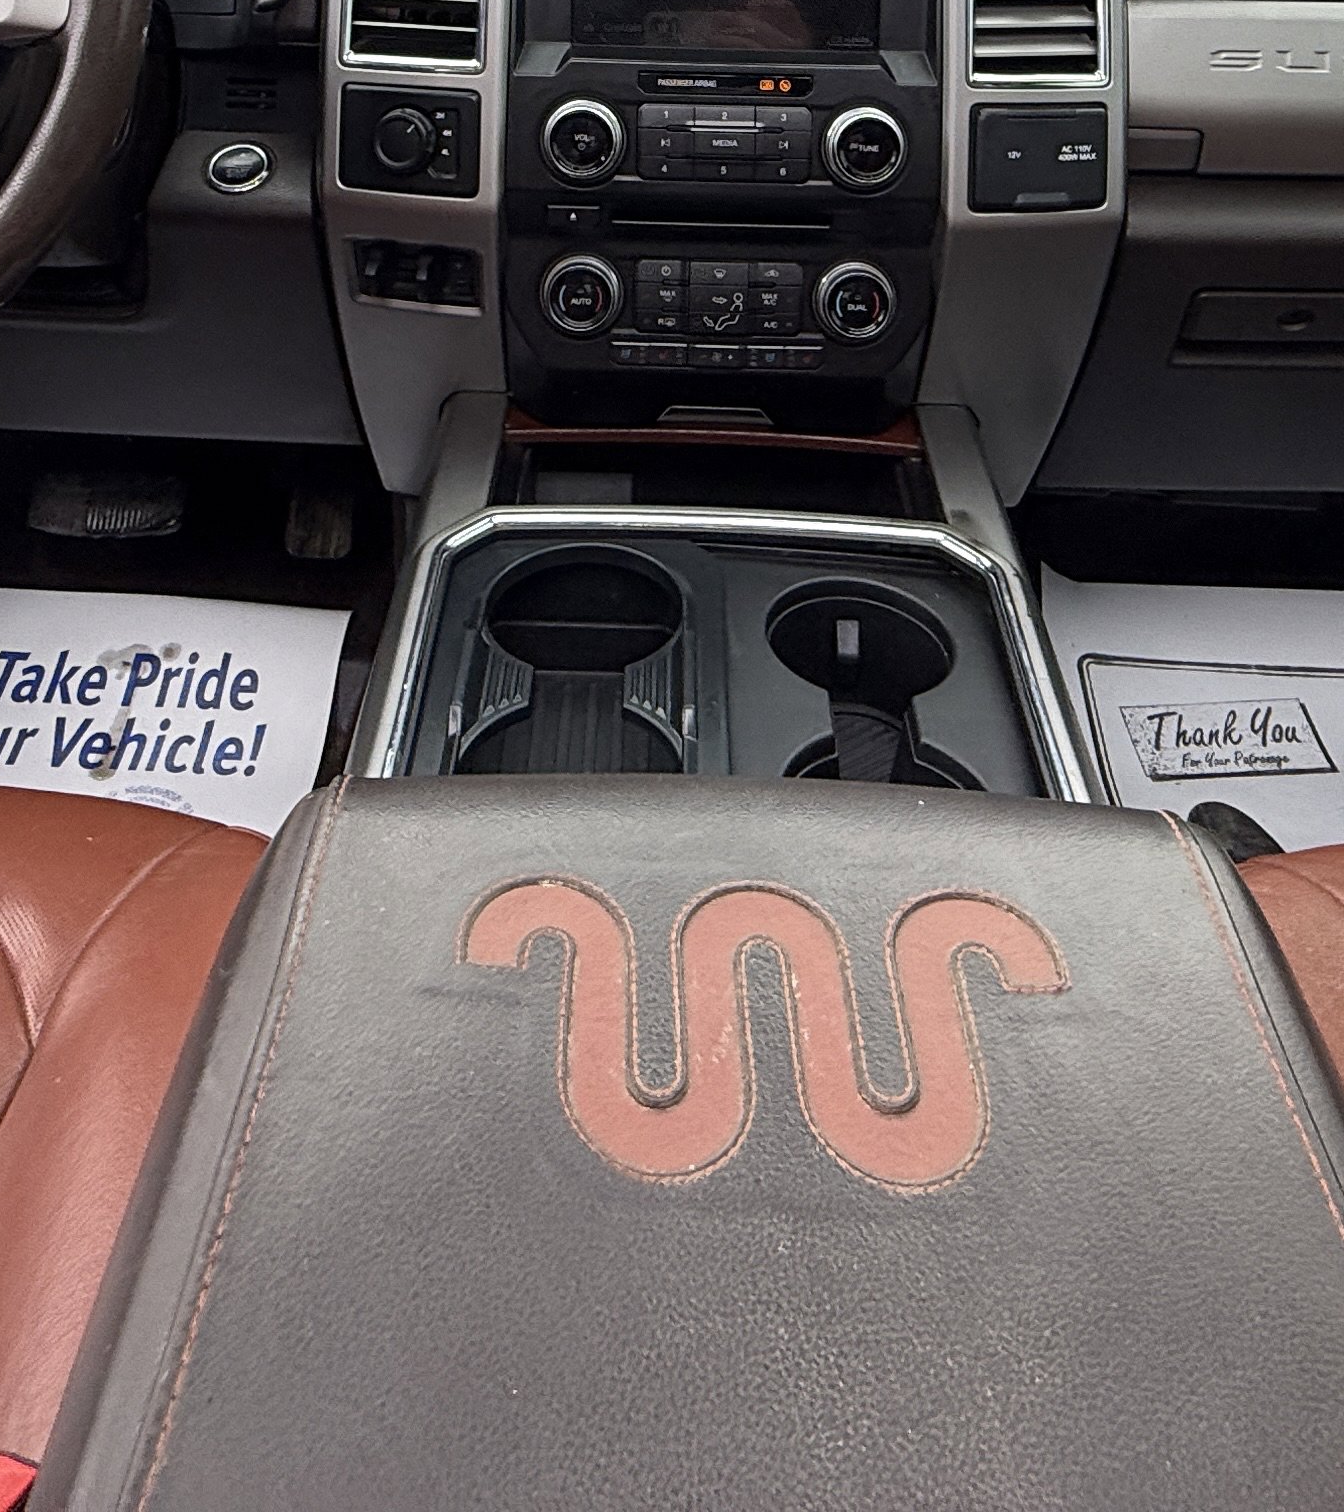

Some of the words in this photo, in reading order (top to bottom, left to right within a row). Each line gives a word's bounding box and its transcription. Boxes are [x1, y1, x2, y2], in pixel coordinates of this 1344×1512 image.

[712, 138, 738, 148] MEDIA
[857, 144, 880, 153] TUNE
[1006, 150, 1023, 160] 12V
[569, 297, 593, 307] AUTO
[846, 303, 869, 312] DUAL
[119, 650, 261, 712] Pride
[1146, 708, 1243, 752] Thank
[1249, 705, 1303, 749] You
[49, 716, 269, 779] Vehicle!
[1181, 751, 1202, 768] For
[1204, 751, 1231, 768] Your
